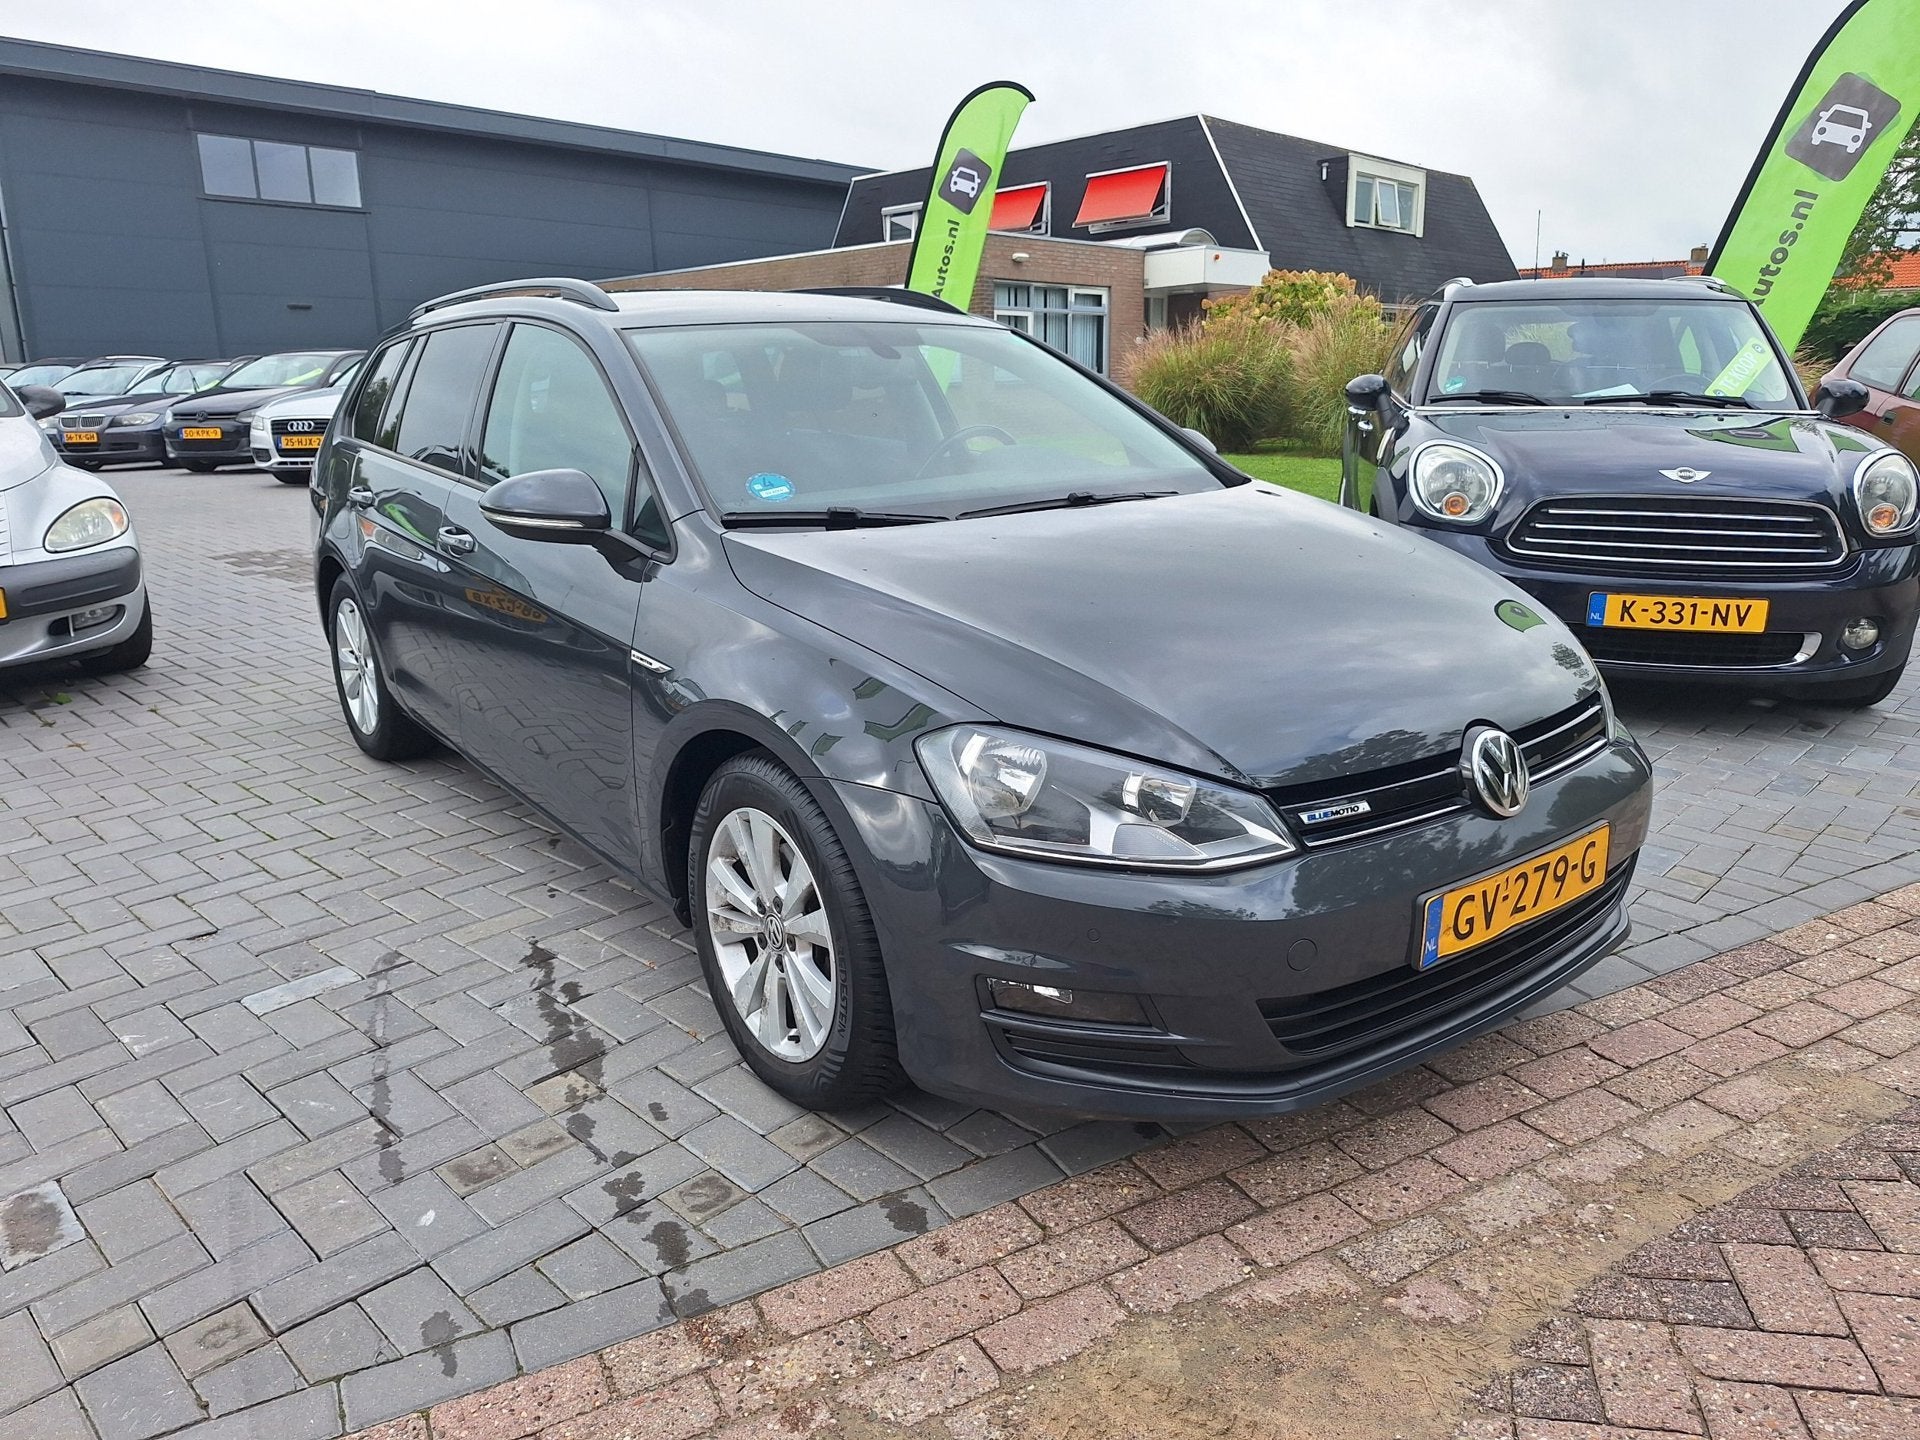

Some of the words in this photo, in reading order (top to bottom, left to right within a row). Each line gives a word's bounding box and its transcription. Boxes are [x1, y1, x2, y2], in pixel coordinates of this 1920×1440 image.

[931, 219, 960, 298] Autos.nl
[1620, 600, 1752, 627] K-331-NV
[1425, 938, 1437, 954] NL
[1452, 841, 1596, 940] GV-279-G
